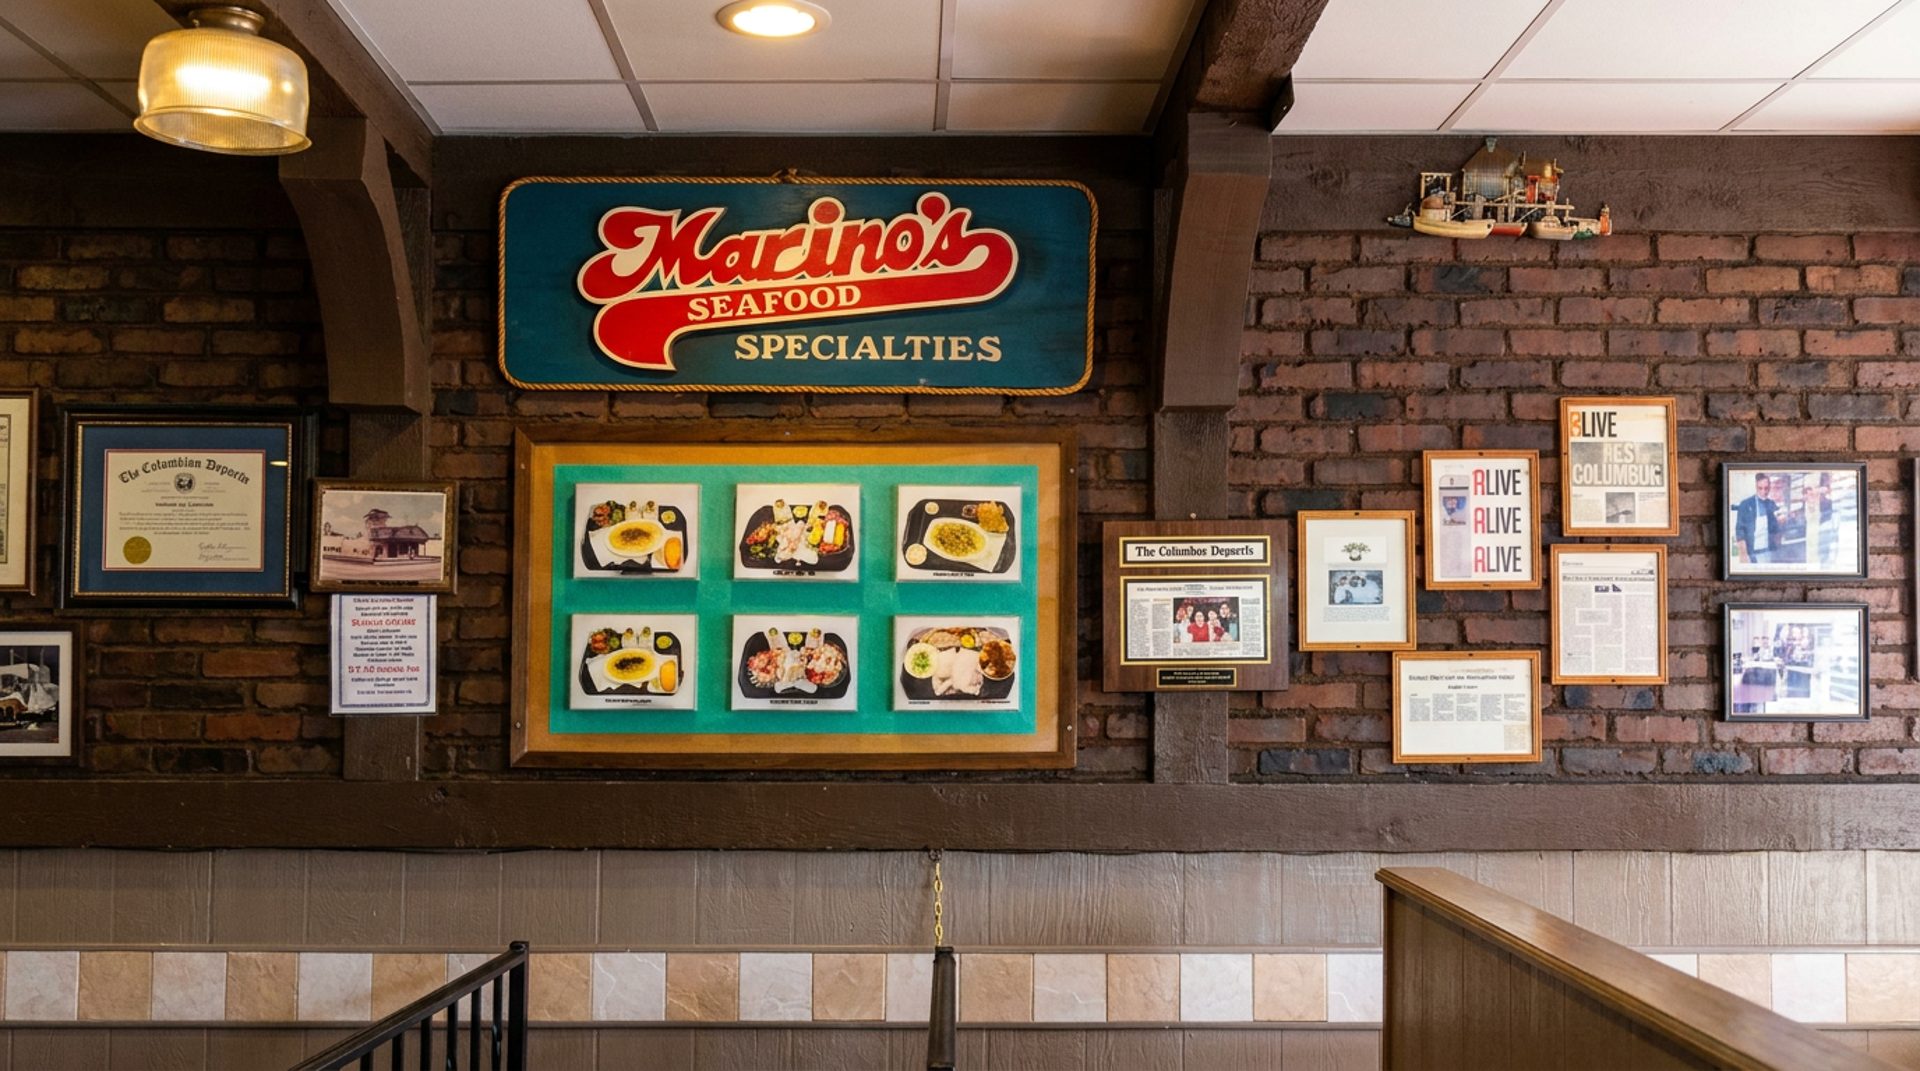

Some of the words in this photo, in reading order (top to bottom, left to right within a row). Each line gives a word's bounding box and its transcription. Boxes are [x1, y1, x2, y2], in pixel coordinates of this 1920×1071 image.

[577, 192, 1000, 303] Marino's
[687, 284, 861, 321] SEAFOOD
[734, 333, 1002, 362] SPECIALTIES
[1135, 545, 1156, 557] The
